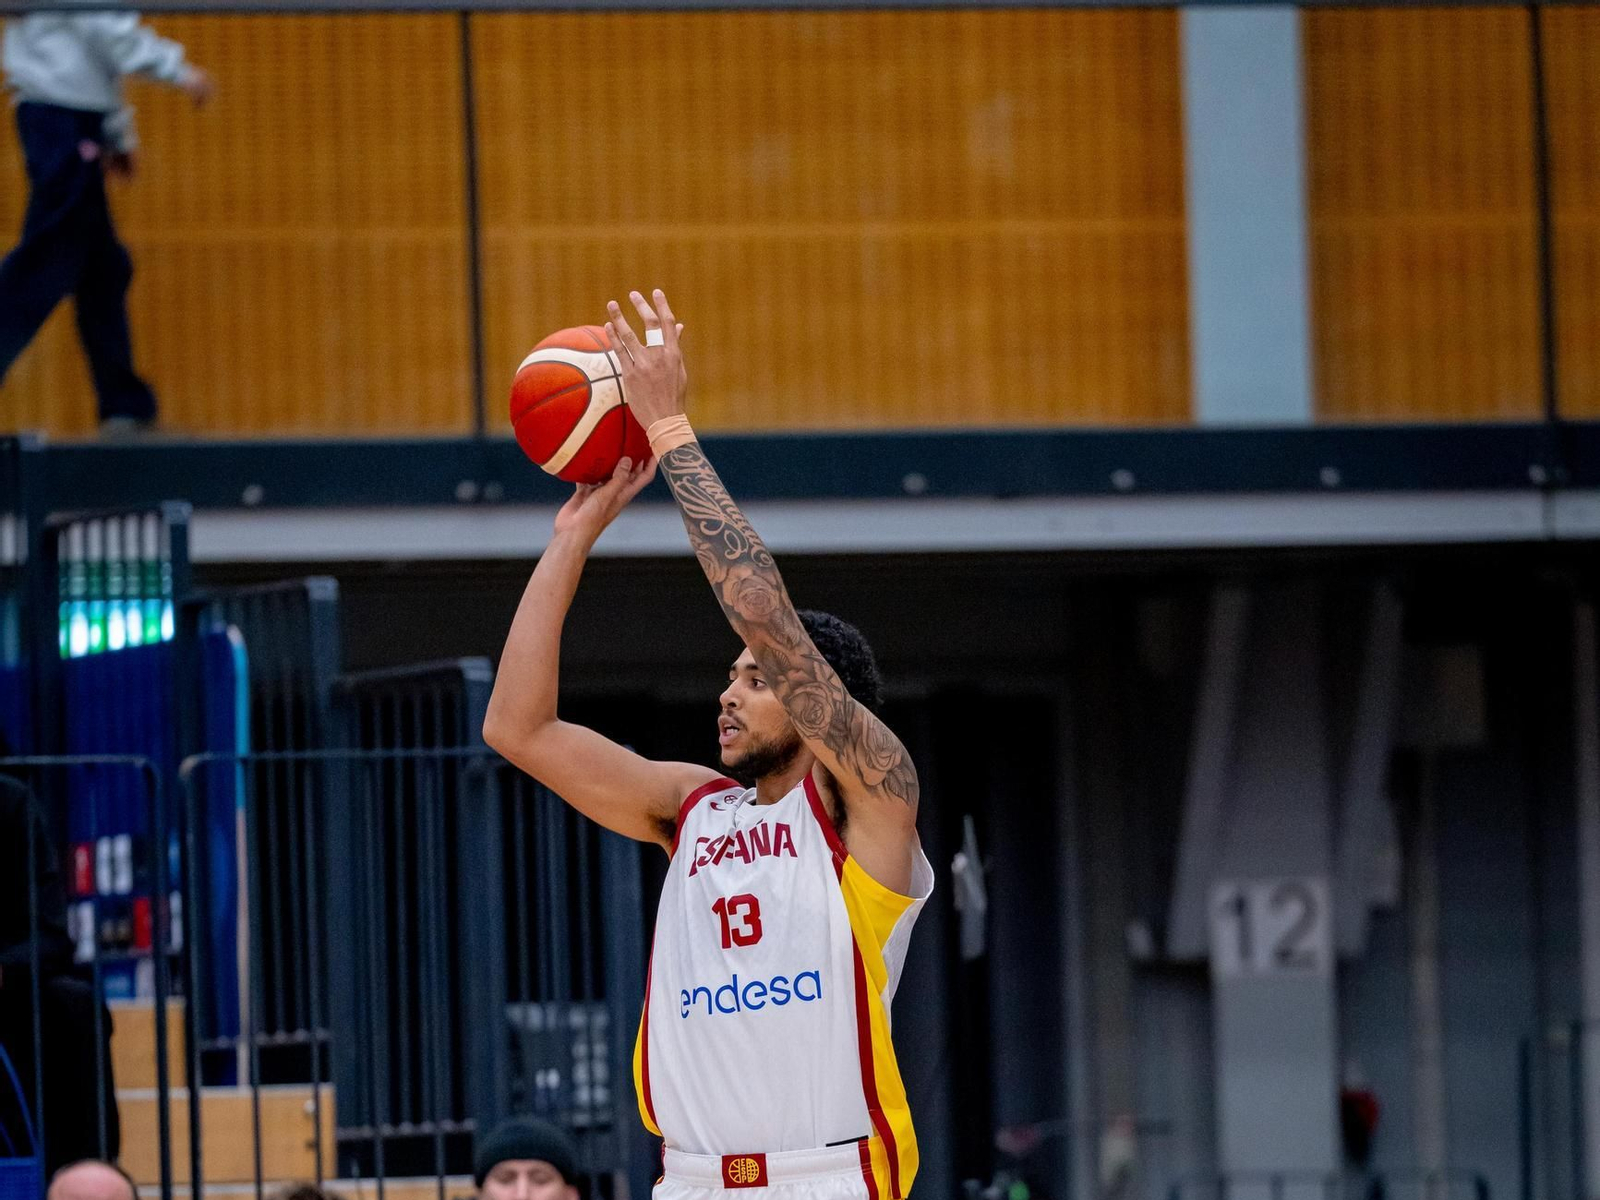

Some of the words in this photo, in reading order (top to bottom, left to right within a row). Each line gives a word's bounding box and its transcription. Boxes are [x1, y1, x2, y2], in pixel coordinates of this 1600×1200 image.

[711, 893, 763, 949] 13
[1220, 884, 1318, 968] 12
[680, 970, 822, 1018] endesa
